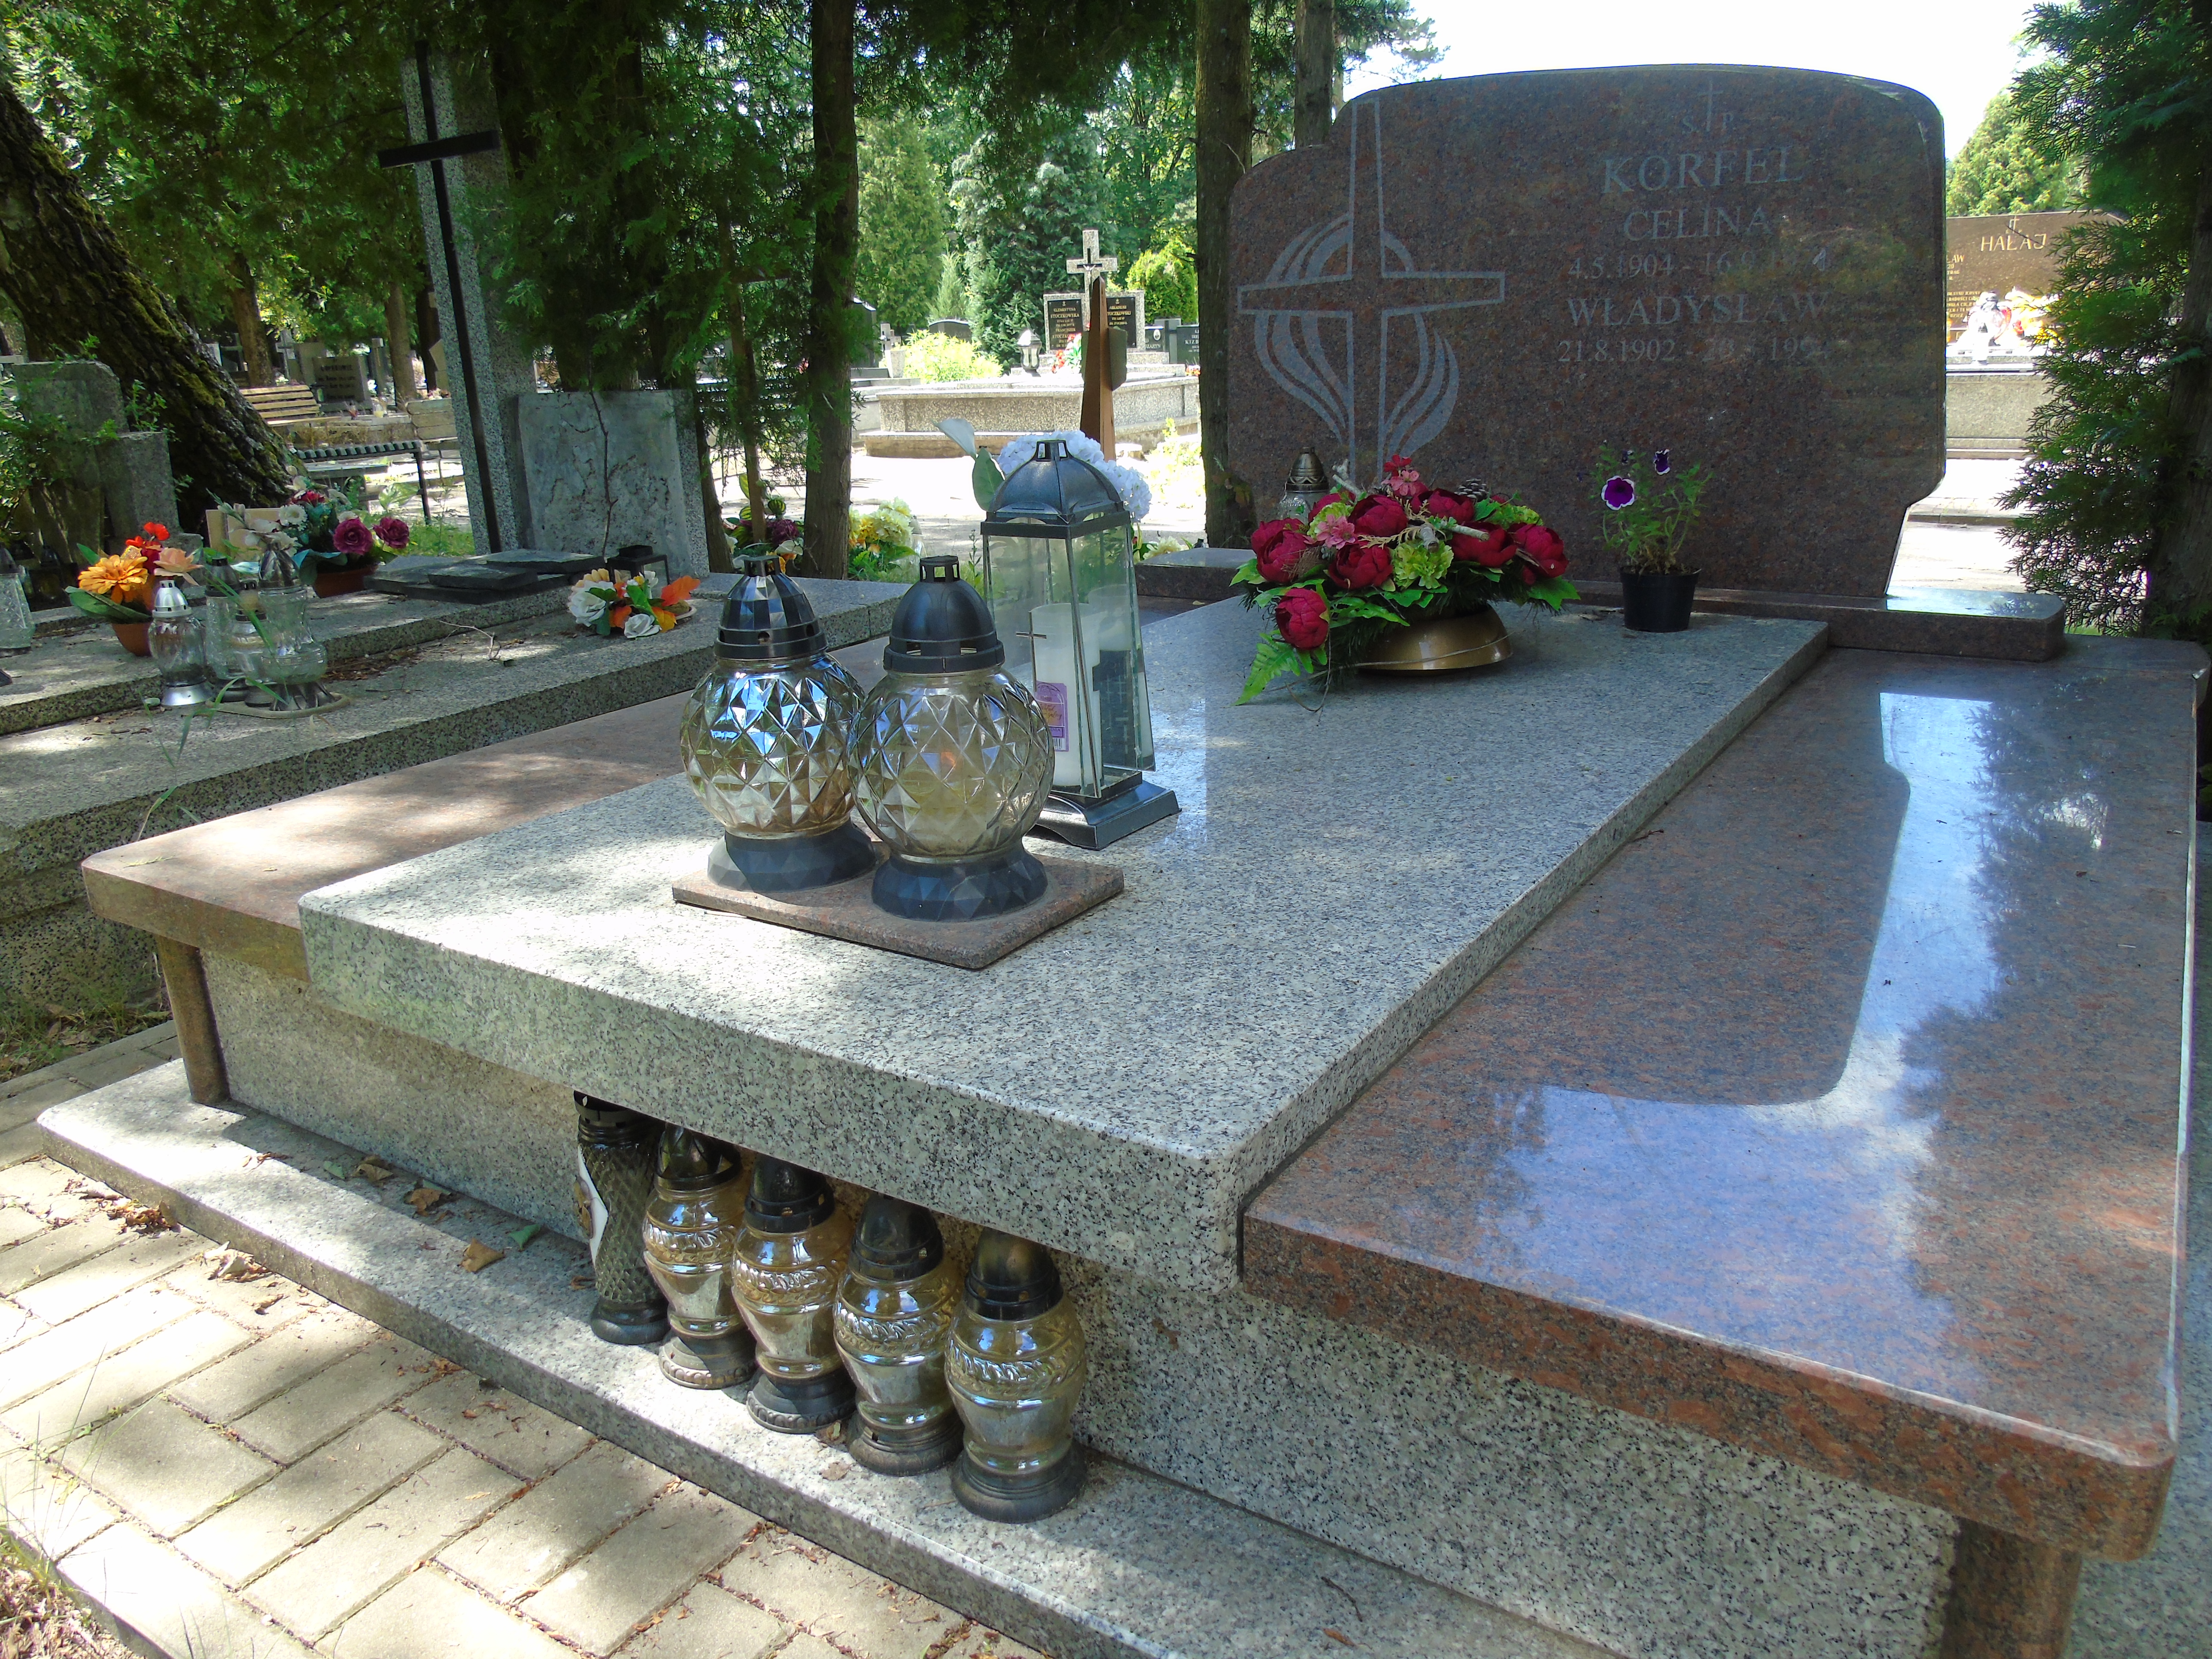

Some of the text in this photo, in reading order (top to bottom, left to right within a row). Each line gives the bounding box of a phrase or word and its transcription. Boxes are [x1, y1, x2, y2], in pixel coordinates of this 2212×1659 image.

[1602, 145, 1805, 193] KORFEL
[1623, 204, 1772, 241] CELINA
[1980, 233, 2047, 252] HAŁAJ
